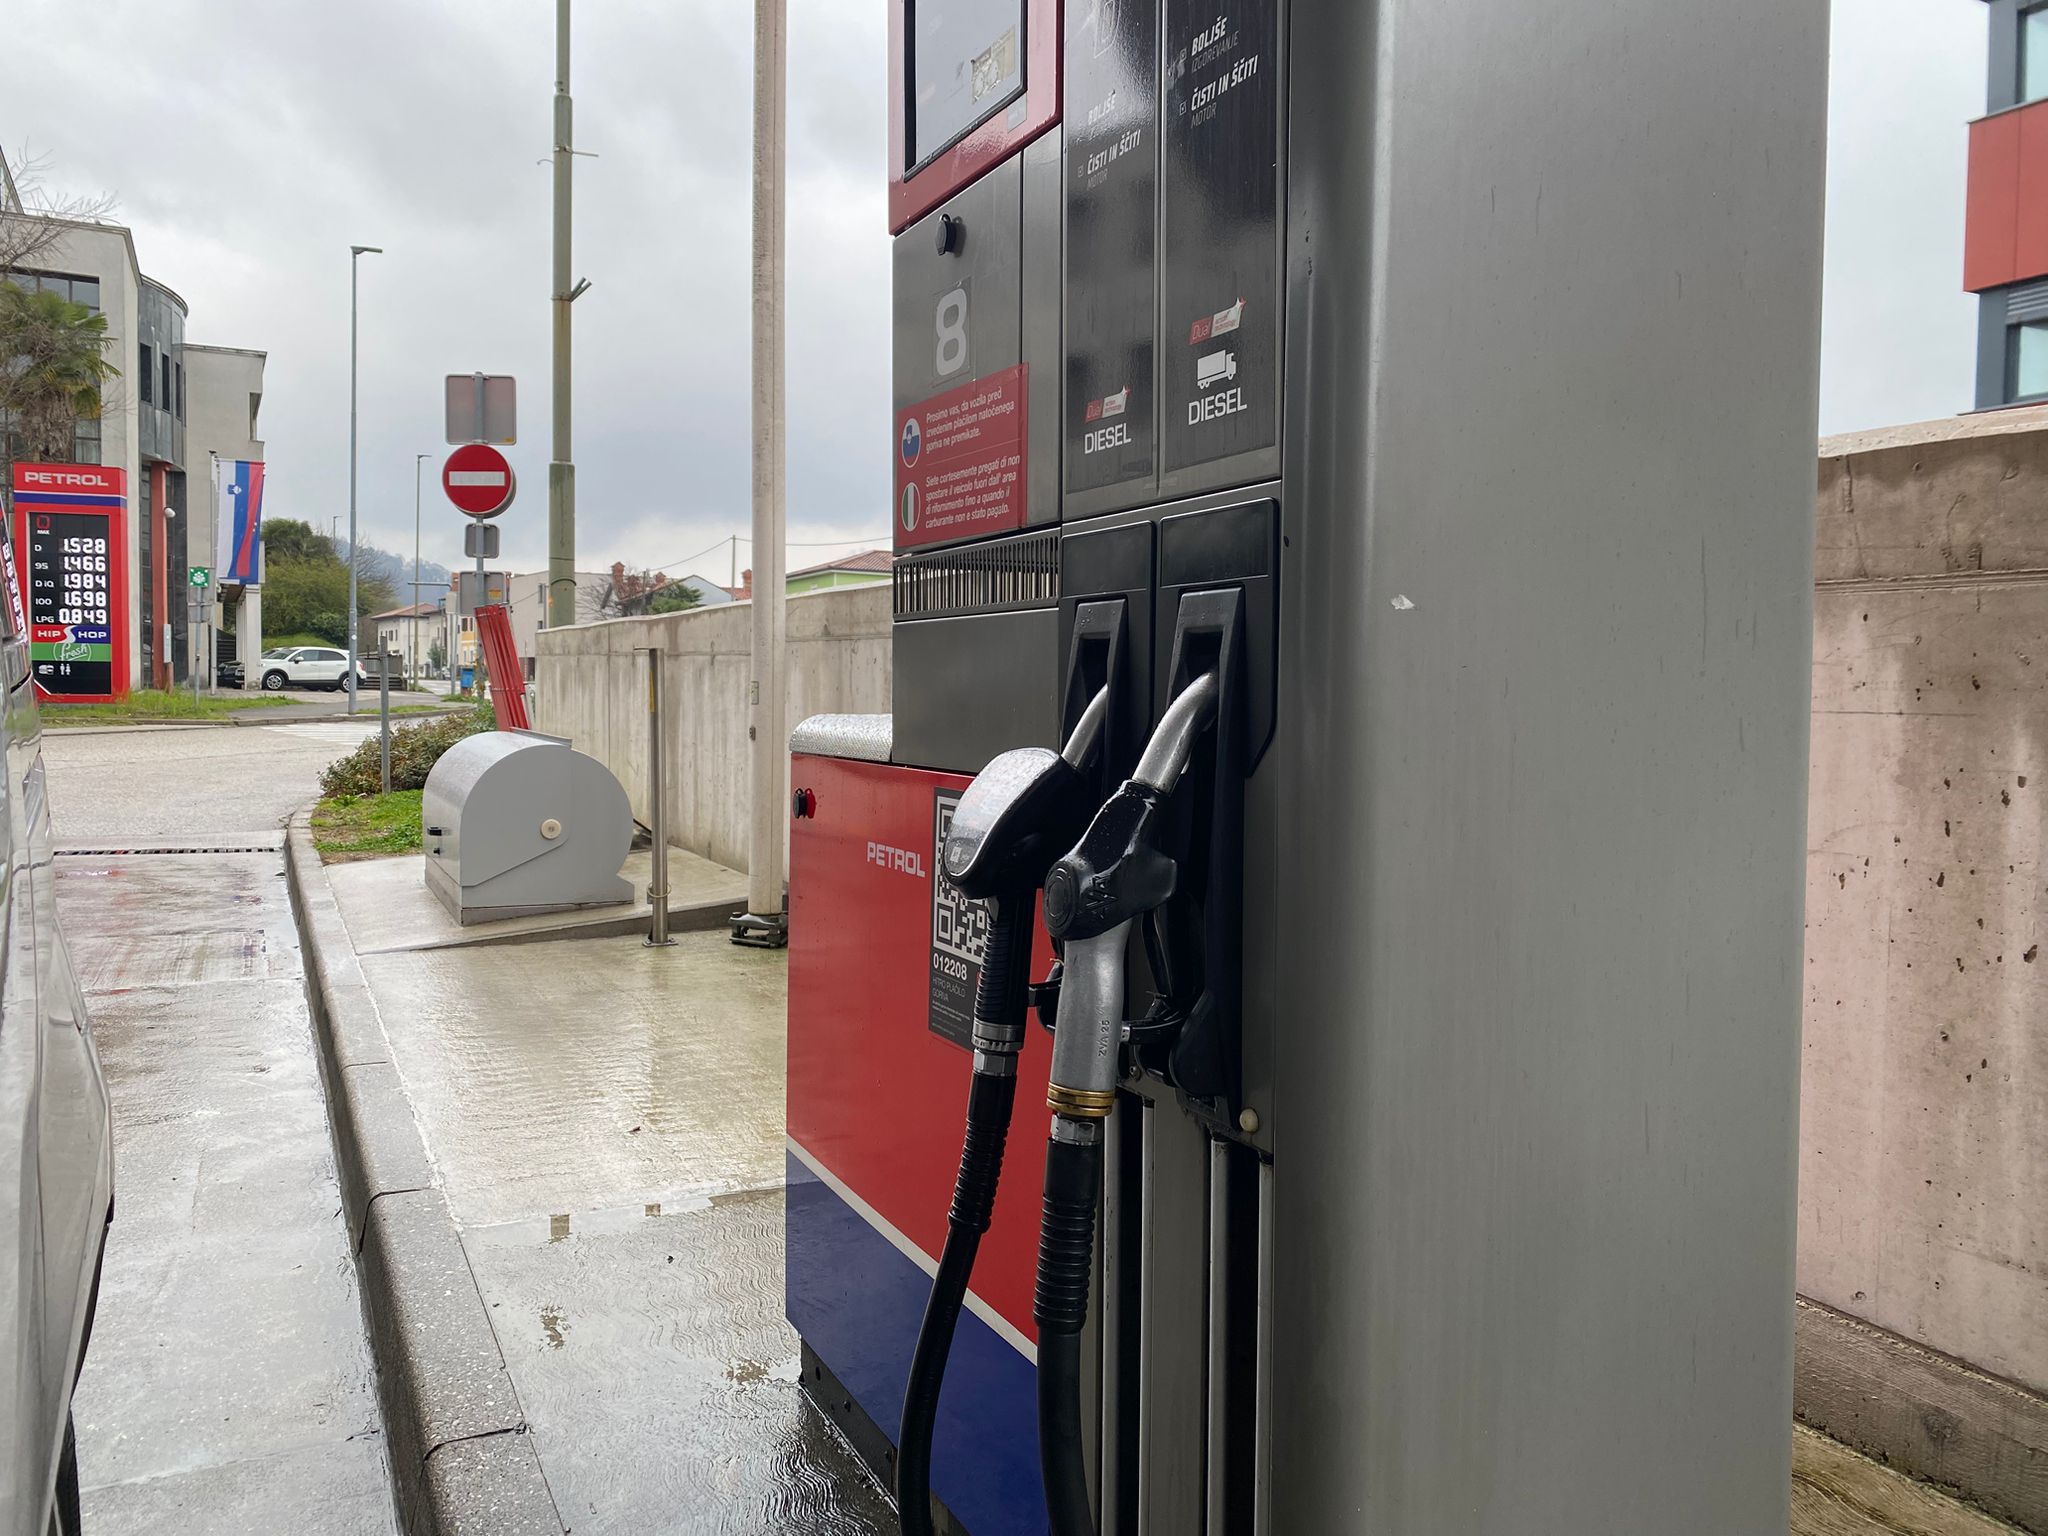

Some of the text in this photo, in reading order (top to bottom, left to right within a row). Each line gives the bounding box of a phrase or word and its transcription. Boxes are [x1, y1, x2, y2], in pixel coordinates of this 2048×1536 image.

[1191, 15, 1228, 57] BOLJŠE
[1191, 54, 1259, 111] ČISTI IN ŠČITI
[1191, 102, 1217, 129] MOTOR
[1087, 129, 1141, 175] ČISTI IN ŠČITI
[935, 287, 967, 376] 8
[927, 408, 948, 423] Prosimo
[961, 400, 969, 411] da
[970, 394, 986, 408] vozila
[987, 386, 1002, 405] pred
[1188, 387, 1248, 426] DIESEL
[1084, 423, 1132, 455] DIESEL
[1000, 456, 1007, 468] di
[1007, 455, 1020, 466] non
[24, 471, 109, 487] PETROL
[953, 481, 973, 495] veicolo
[973, 477, 988, 490] fuori
[1002, 471, 1016, 483] area
[965, 495, 976, 506] fino
[982, 488, 1004, 505] quando
[955, 512, 965, 522] non
[971, 508, 986, 520] stato
[34, 544, 42, 552] D
[34, 562, 49, 570] 95
[35, 580, 43, 588] D
[37, 630, 61, 638] HIP
[867, 841, 926, 878] PETROL
[933, 953, 967, 980] 012208
